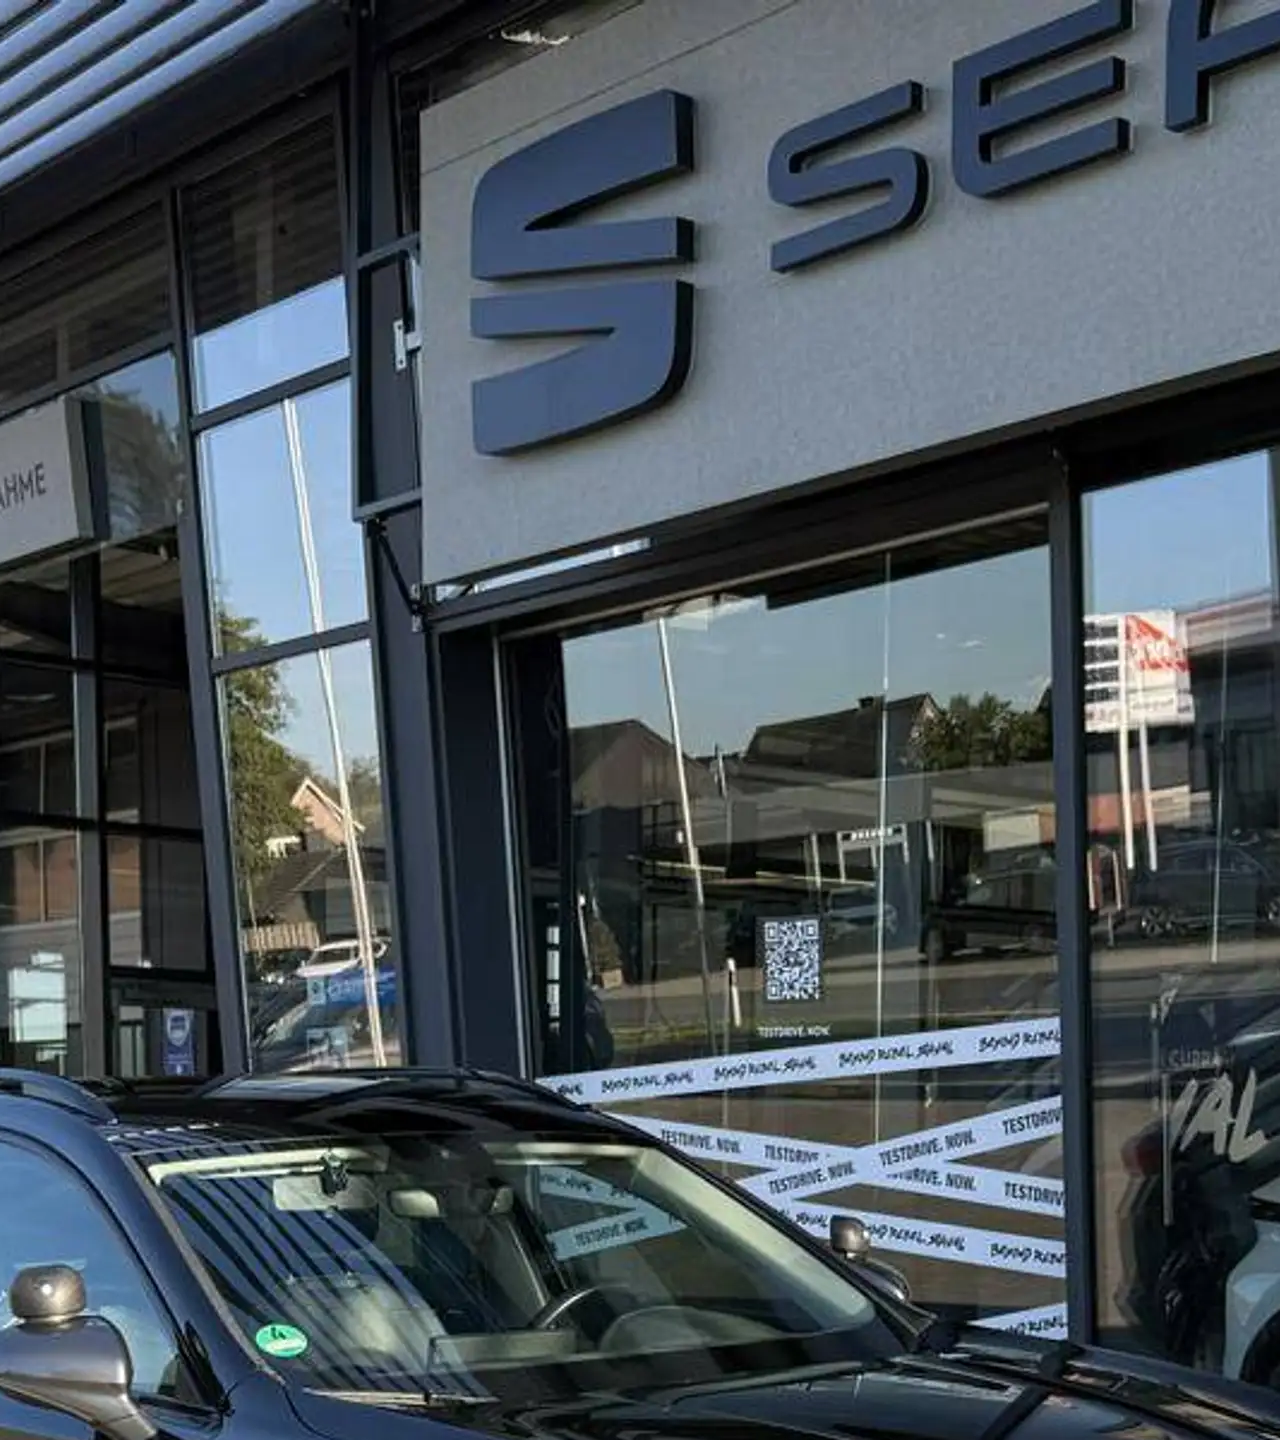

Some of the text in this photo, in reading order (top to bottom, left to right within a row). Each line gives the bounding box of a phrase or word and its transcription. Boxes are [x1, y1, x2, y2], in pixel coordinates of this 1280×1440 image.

[878, 1130, 976, 1167] TESTDRIVE. NOW.
[945, 1172, 977, 1191] NOW.
